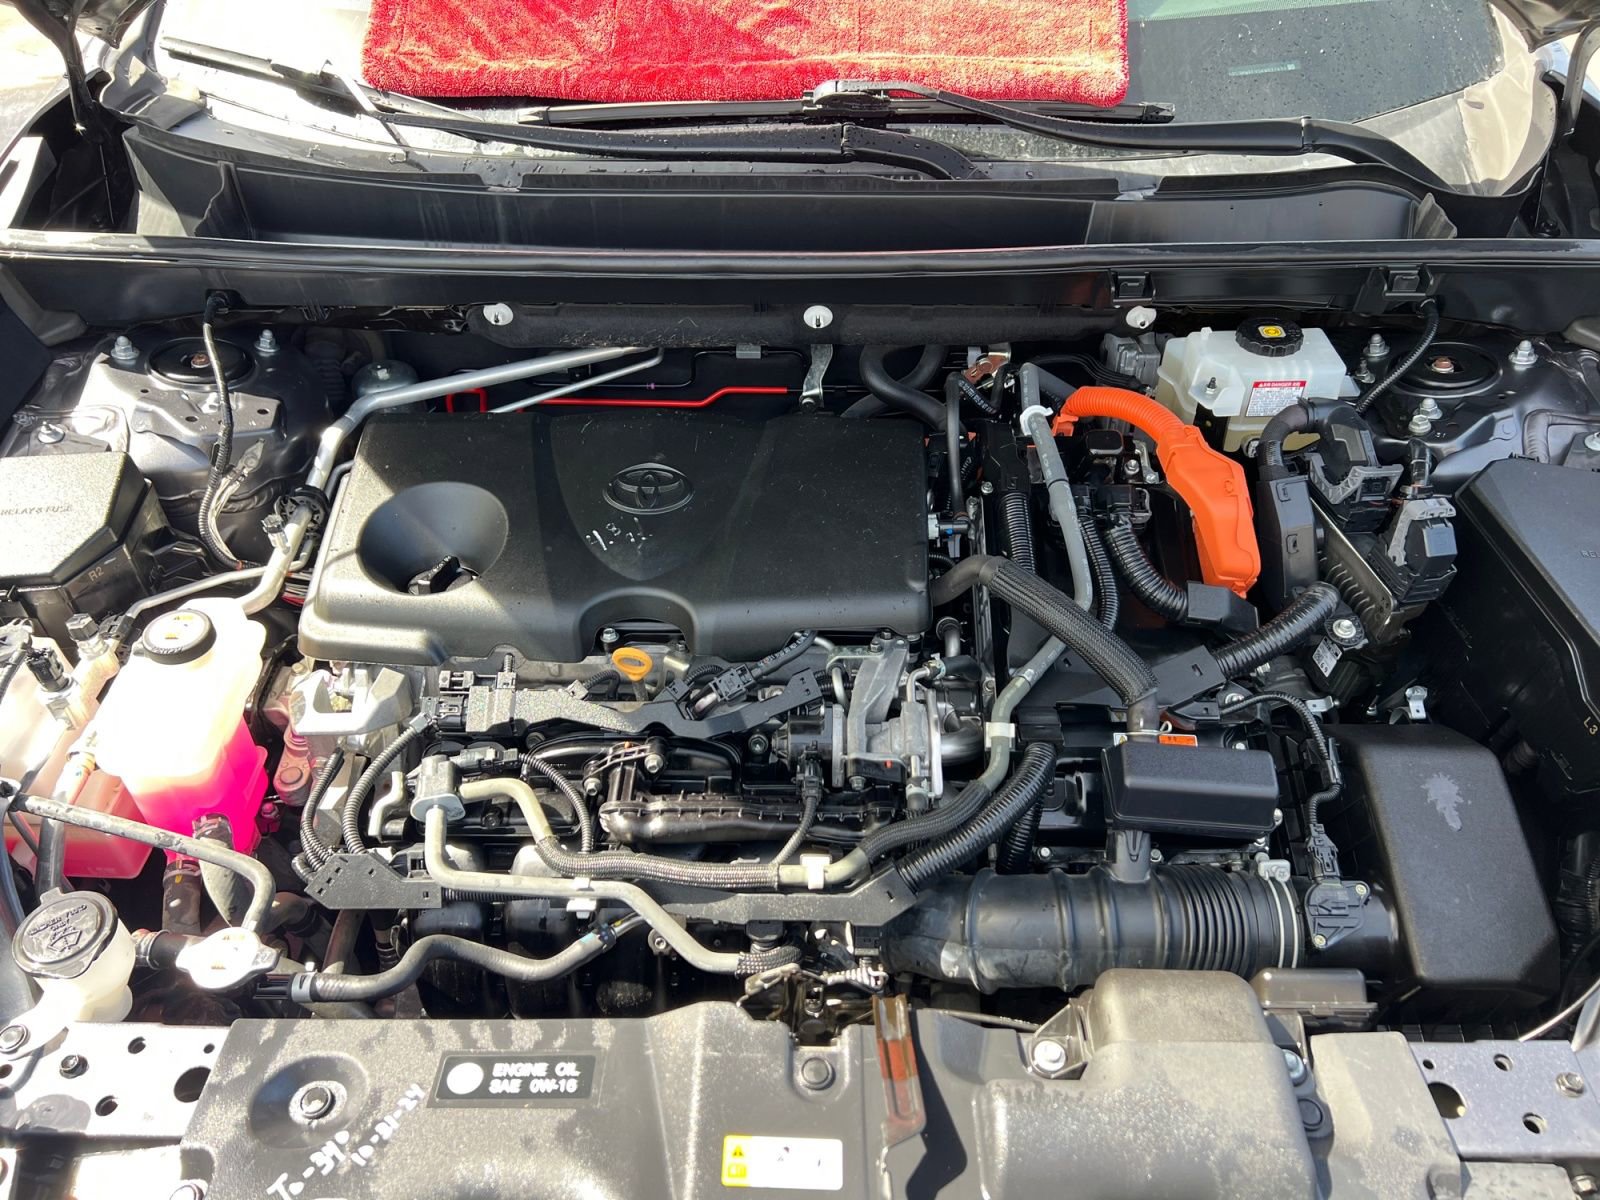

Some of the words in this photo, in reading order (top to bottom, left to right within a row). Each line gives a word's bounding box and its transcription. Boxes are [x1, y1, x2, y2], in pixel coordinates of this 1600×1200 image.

[88, 566, 104, 582] R2
[492, 1062, 548, 1077] ENGINE
[554, 1062, 581, 1077] OIL
[488, 1078, 523, 1094] SAE
